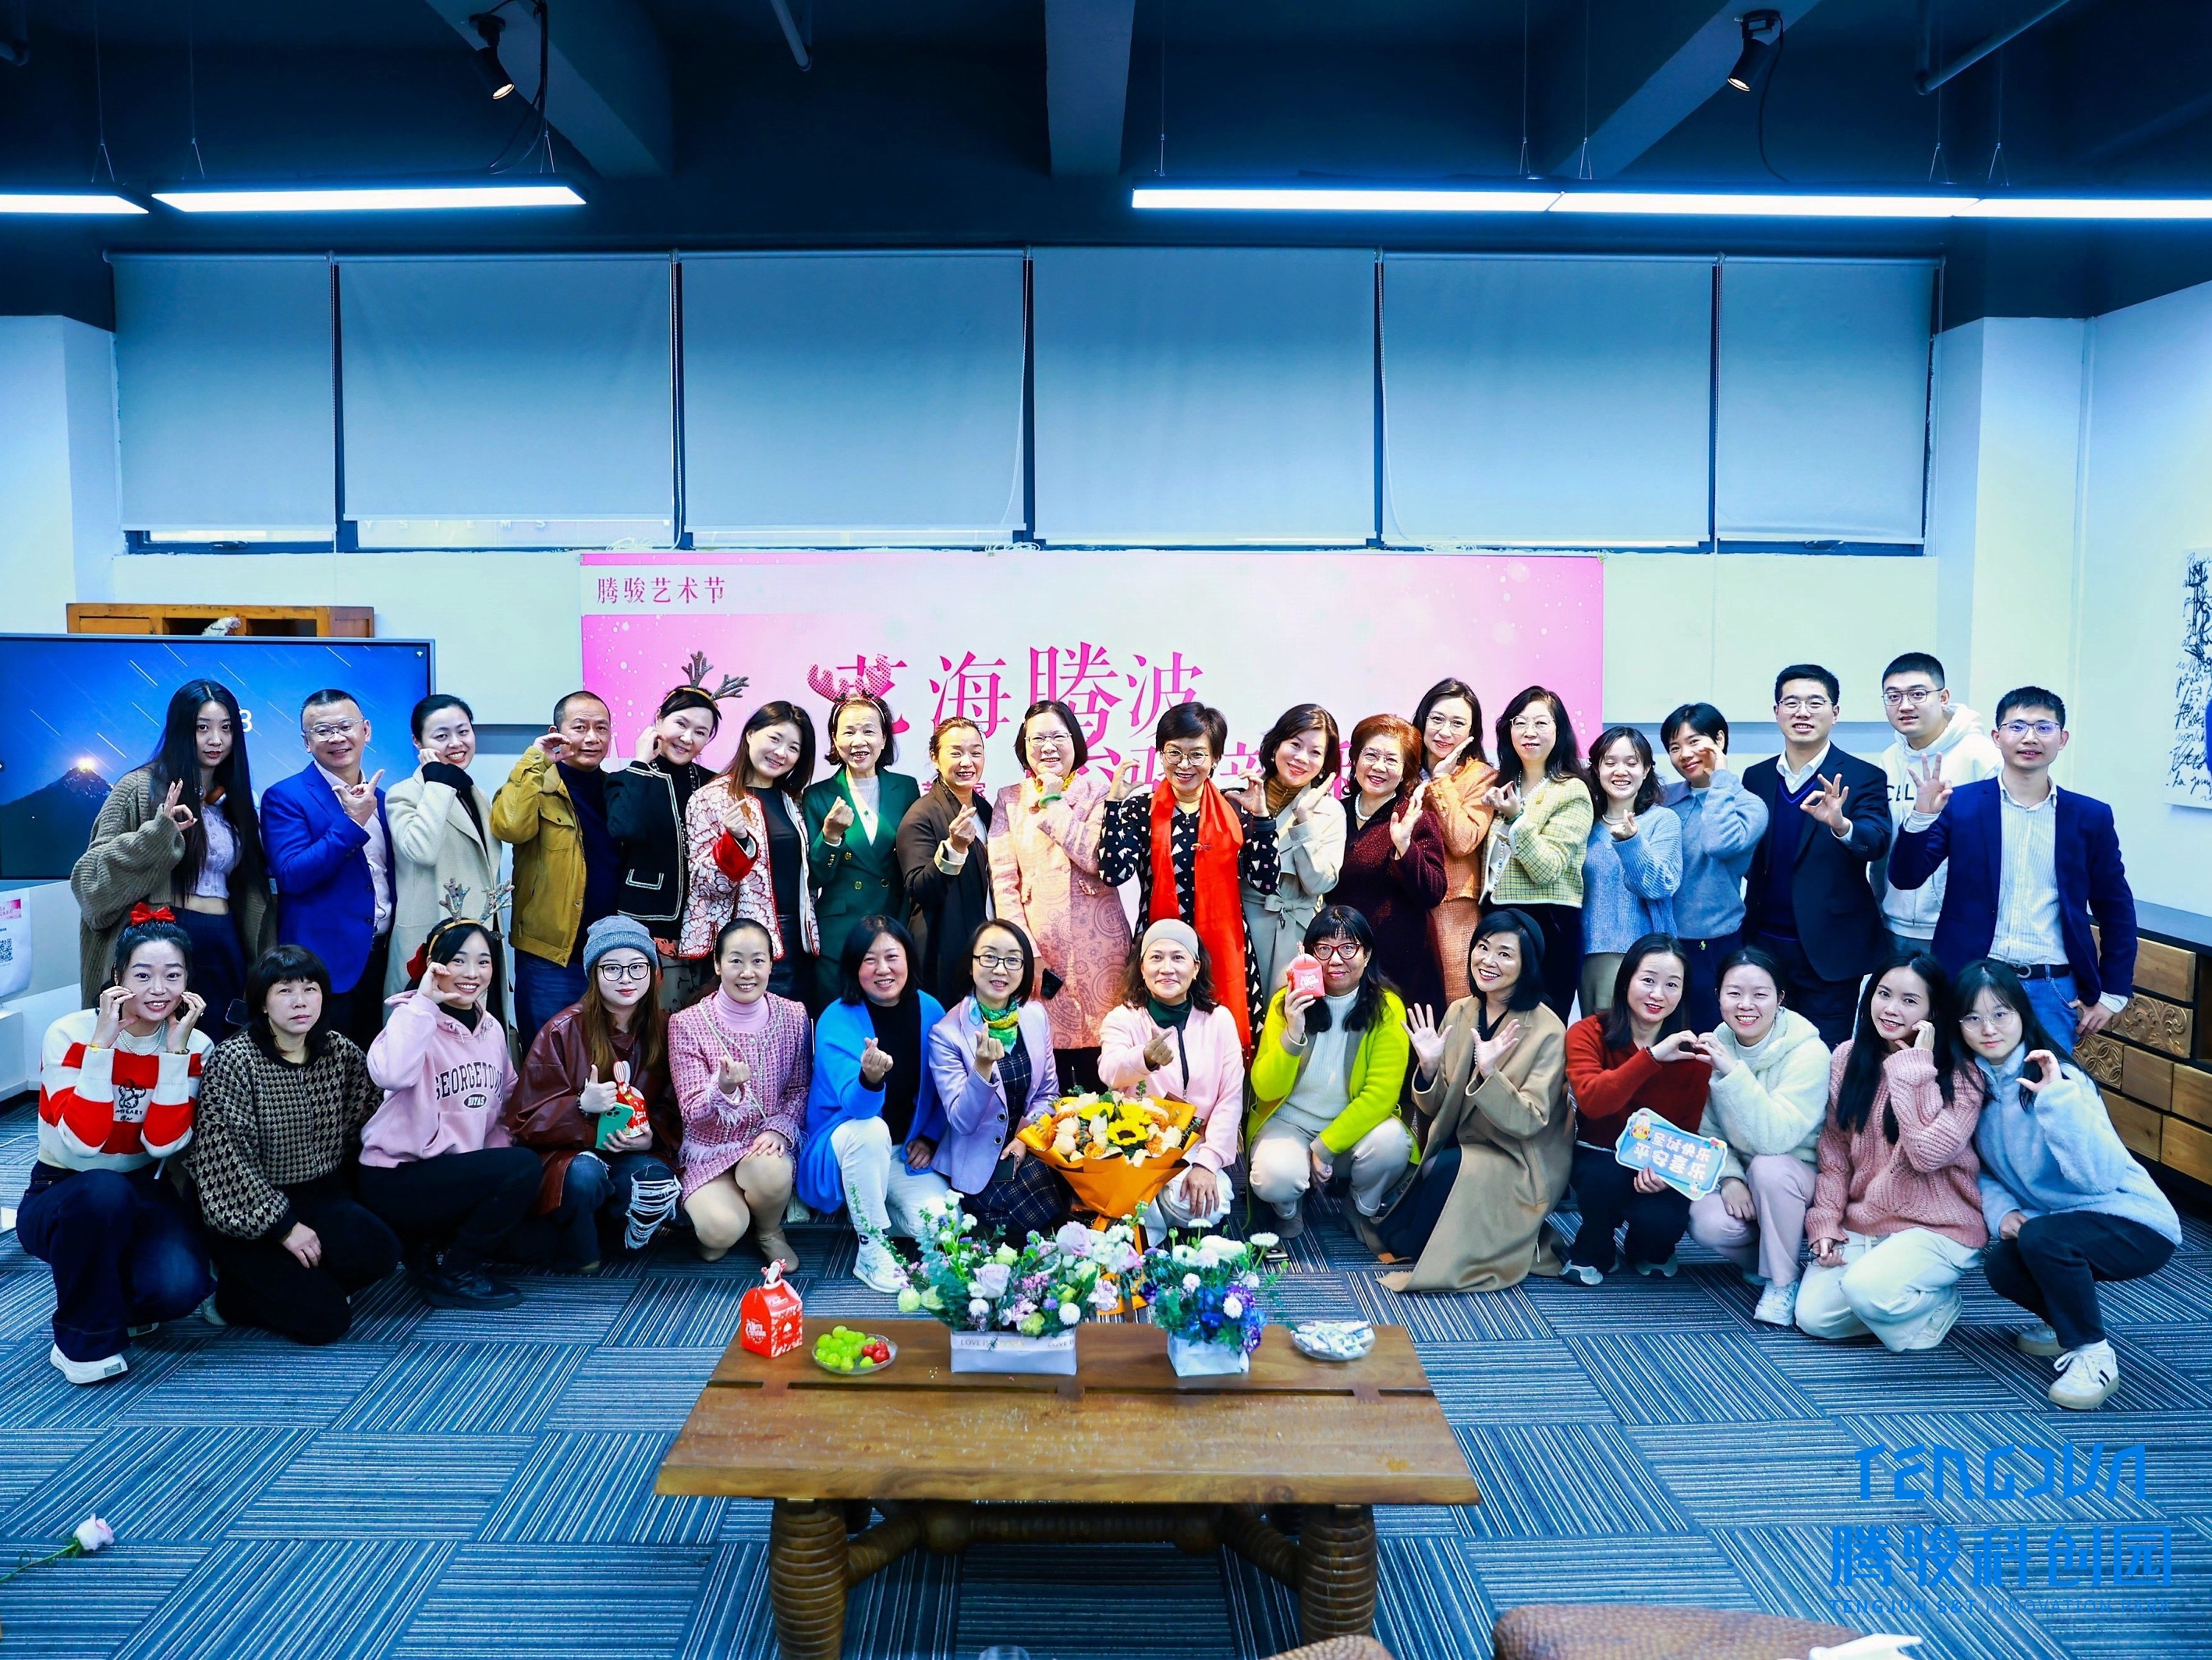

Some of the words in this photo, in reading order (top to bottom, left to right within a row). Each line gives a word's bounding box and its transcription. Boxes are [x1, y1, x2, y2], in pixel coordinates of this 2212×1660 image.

[597, 576, 725, 604] 腾骏艺术节
[1633, 1141, 1707, 1180] 平安喜乐
[1651, 1131, 1712, 1162] 圣诞快乐
